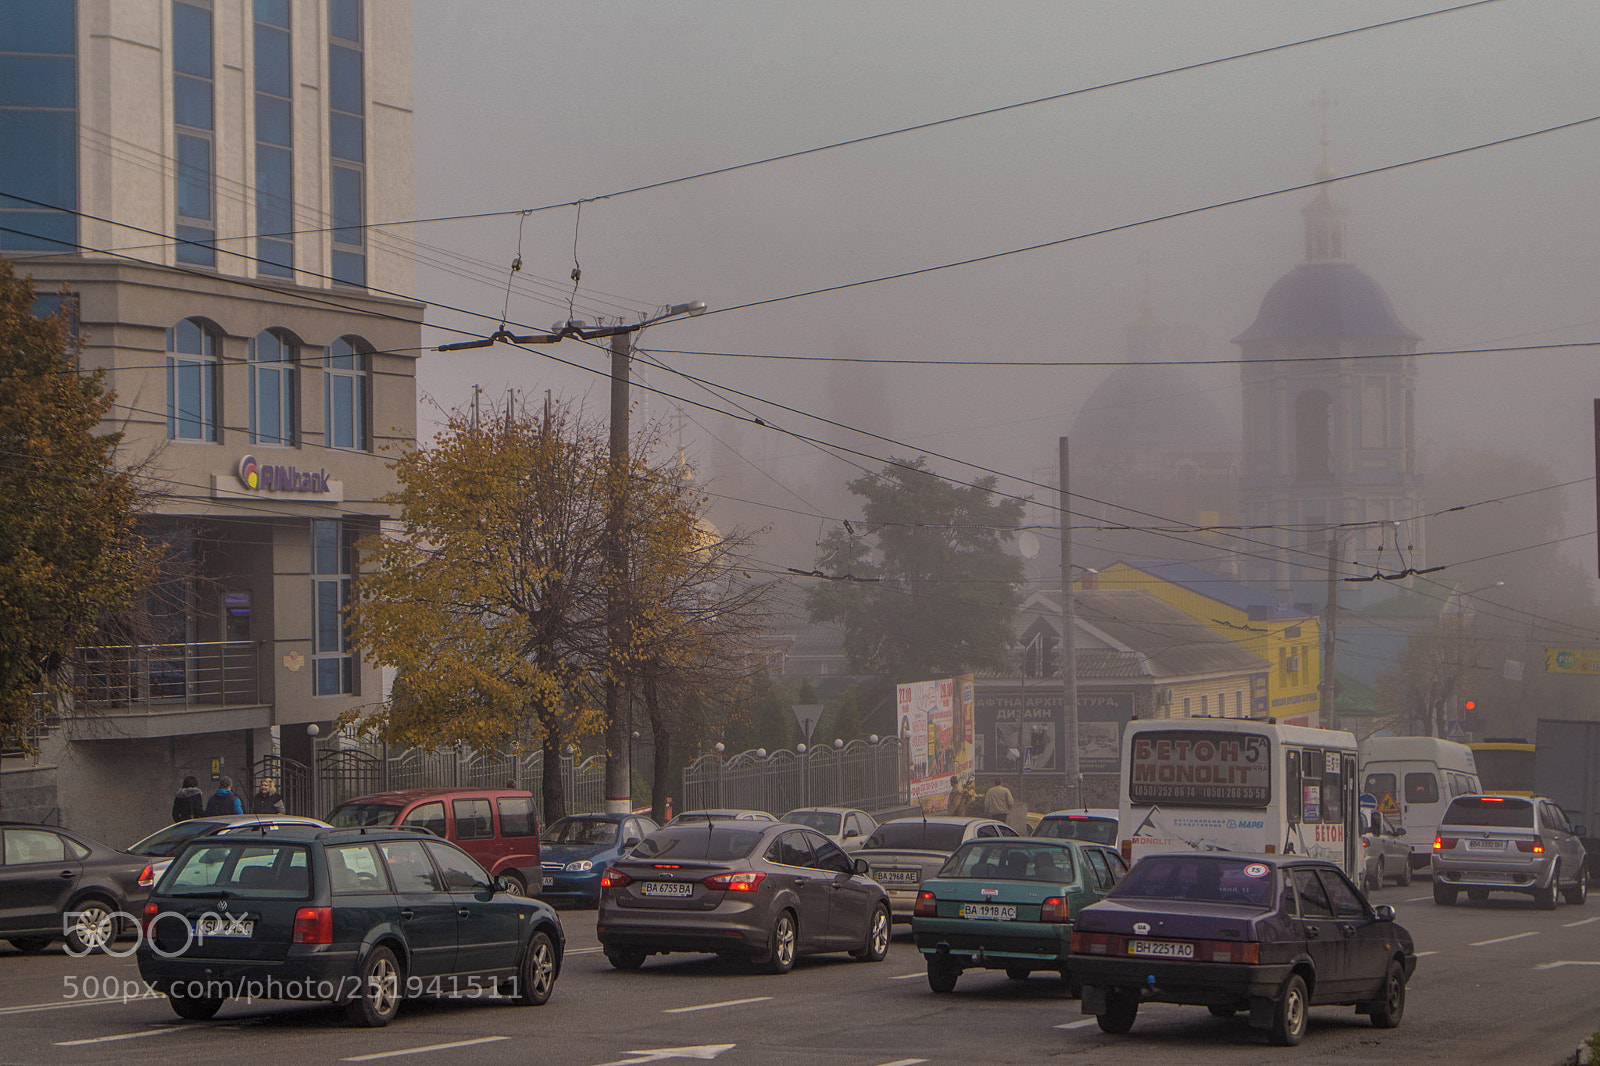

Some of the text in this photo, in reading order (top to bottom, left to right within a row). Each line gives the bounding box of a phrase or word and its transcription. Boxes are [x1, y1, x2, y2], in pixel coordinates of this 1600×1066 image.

[259, 464, 330, 493] PINbank
[976, 697, 1119, 709] АФТНА АРХІТТУРА,
[996, 707, 1051, 720] ДИЗАЙН
[1135, 741, 1239, 763] БЕТОН
[1135, 764, 1252, 785] MONOLIT
[1238, 821, 1264, 829] MAPEI
[1315, 825, 1343, 842] БЕТОН
[1132, 837, 1173, 846] MONOLIT
[877, 872, 888, 880] BA
[646, 883, 690, 894] BA 6755 BA
[965, 905, 1014, 917] BA 1918 AC
[1136, 942, 1150, 953] BH
[1152, 943, 1175, 955] 2251
